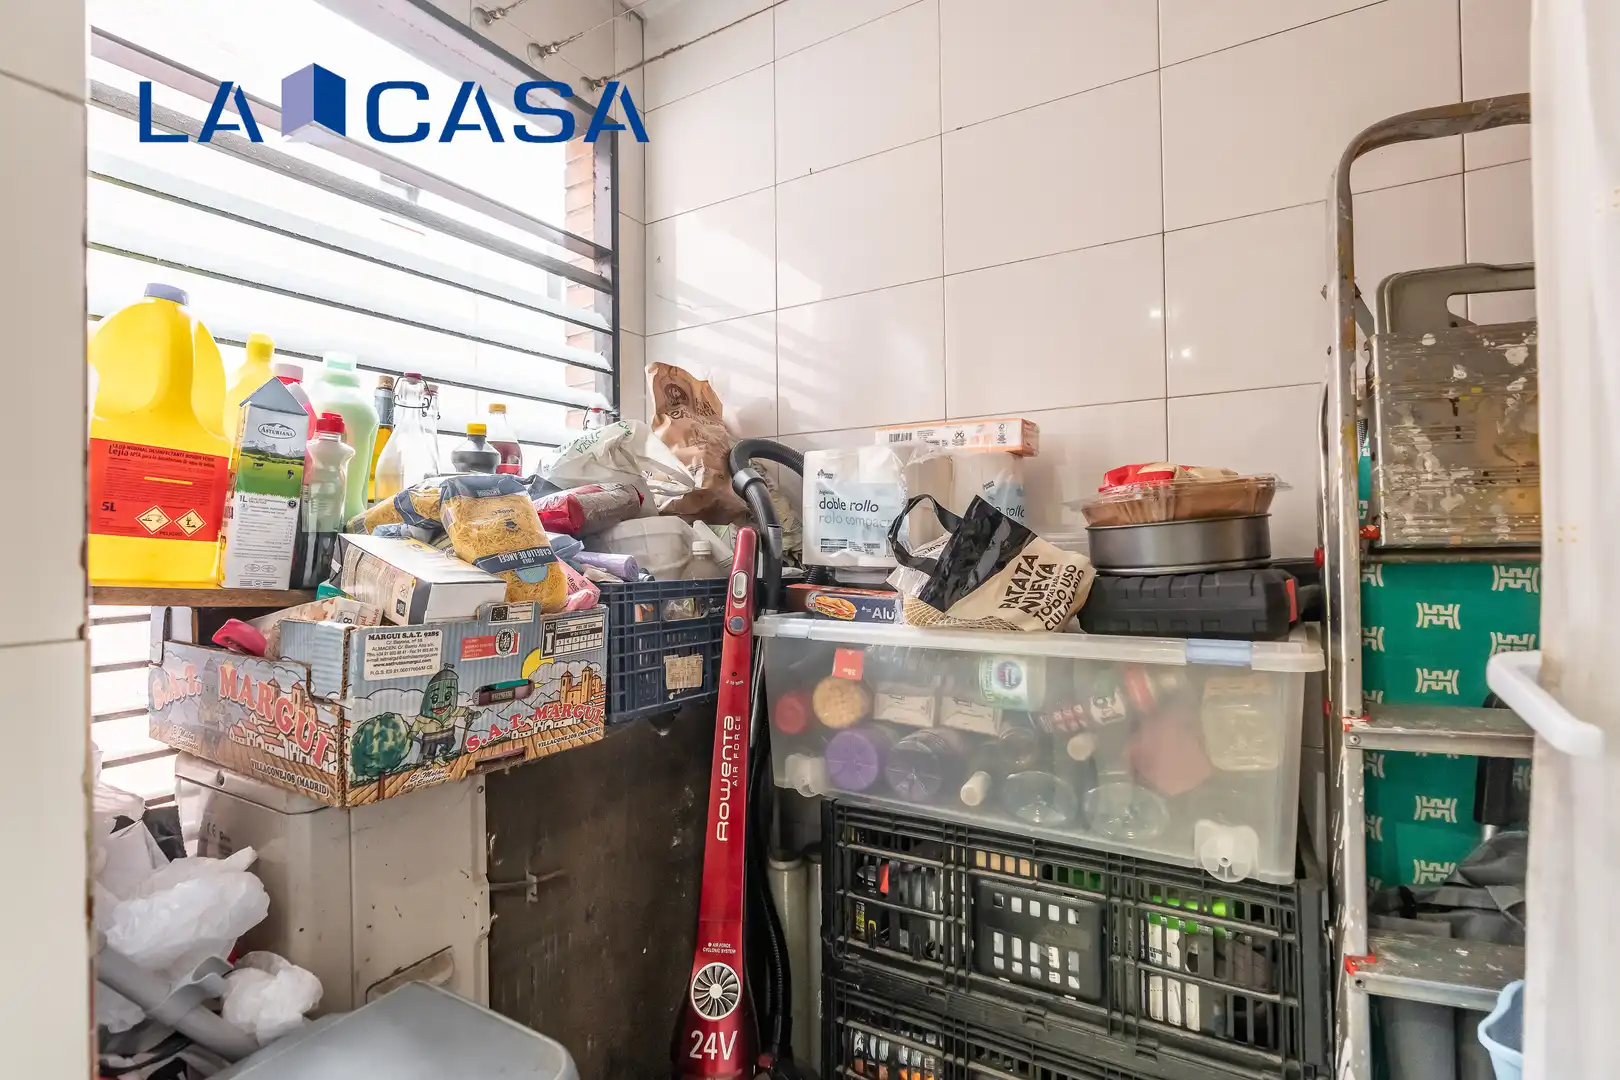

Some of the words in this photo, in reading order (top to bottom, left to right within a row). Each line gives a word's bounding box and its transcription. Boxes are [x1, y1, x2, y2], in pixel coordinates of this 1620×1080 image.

[261, 427, 293, 437] ASTURIANA
[101, 501, 116, 512] 5L
[819, 497, 846, 511] doble
[849, 500, 879, 513] rollo
[819, 511, 843, 524] rolo
[998, 555, 1039, 608] PATATA
[1019, 564, 1057, 614] NUEVA
[1033, 589, 1067, 621] TODO
[1060, 564, 1077, 588] USO
[871, 607, 896, 620] Alu
[218, 665, 328, 770] MARGUI
[465, 713, 525, 753] S.A.T.
[533, 702, 602, 725] MARGUI
[537, 731, 577, 749] VILLACONEJOS
[733, 716, 741, 759] FORCE
[251, 758, 296, 784] VILLACONEJOS
[296, 776, 331, 797] (MADRID)
[689, 1029, 738, 1061] 24V
